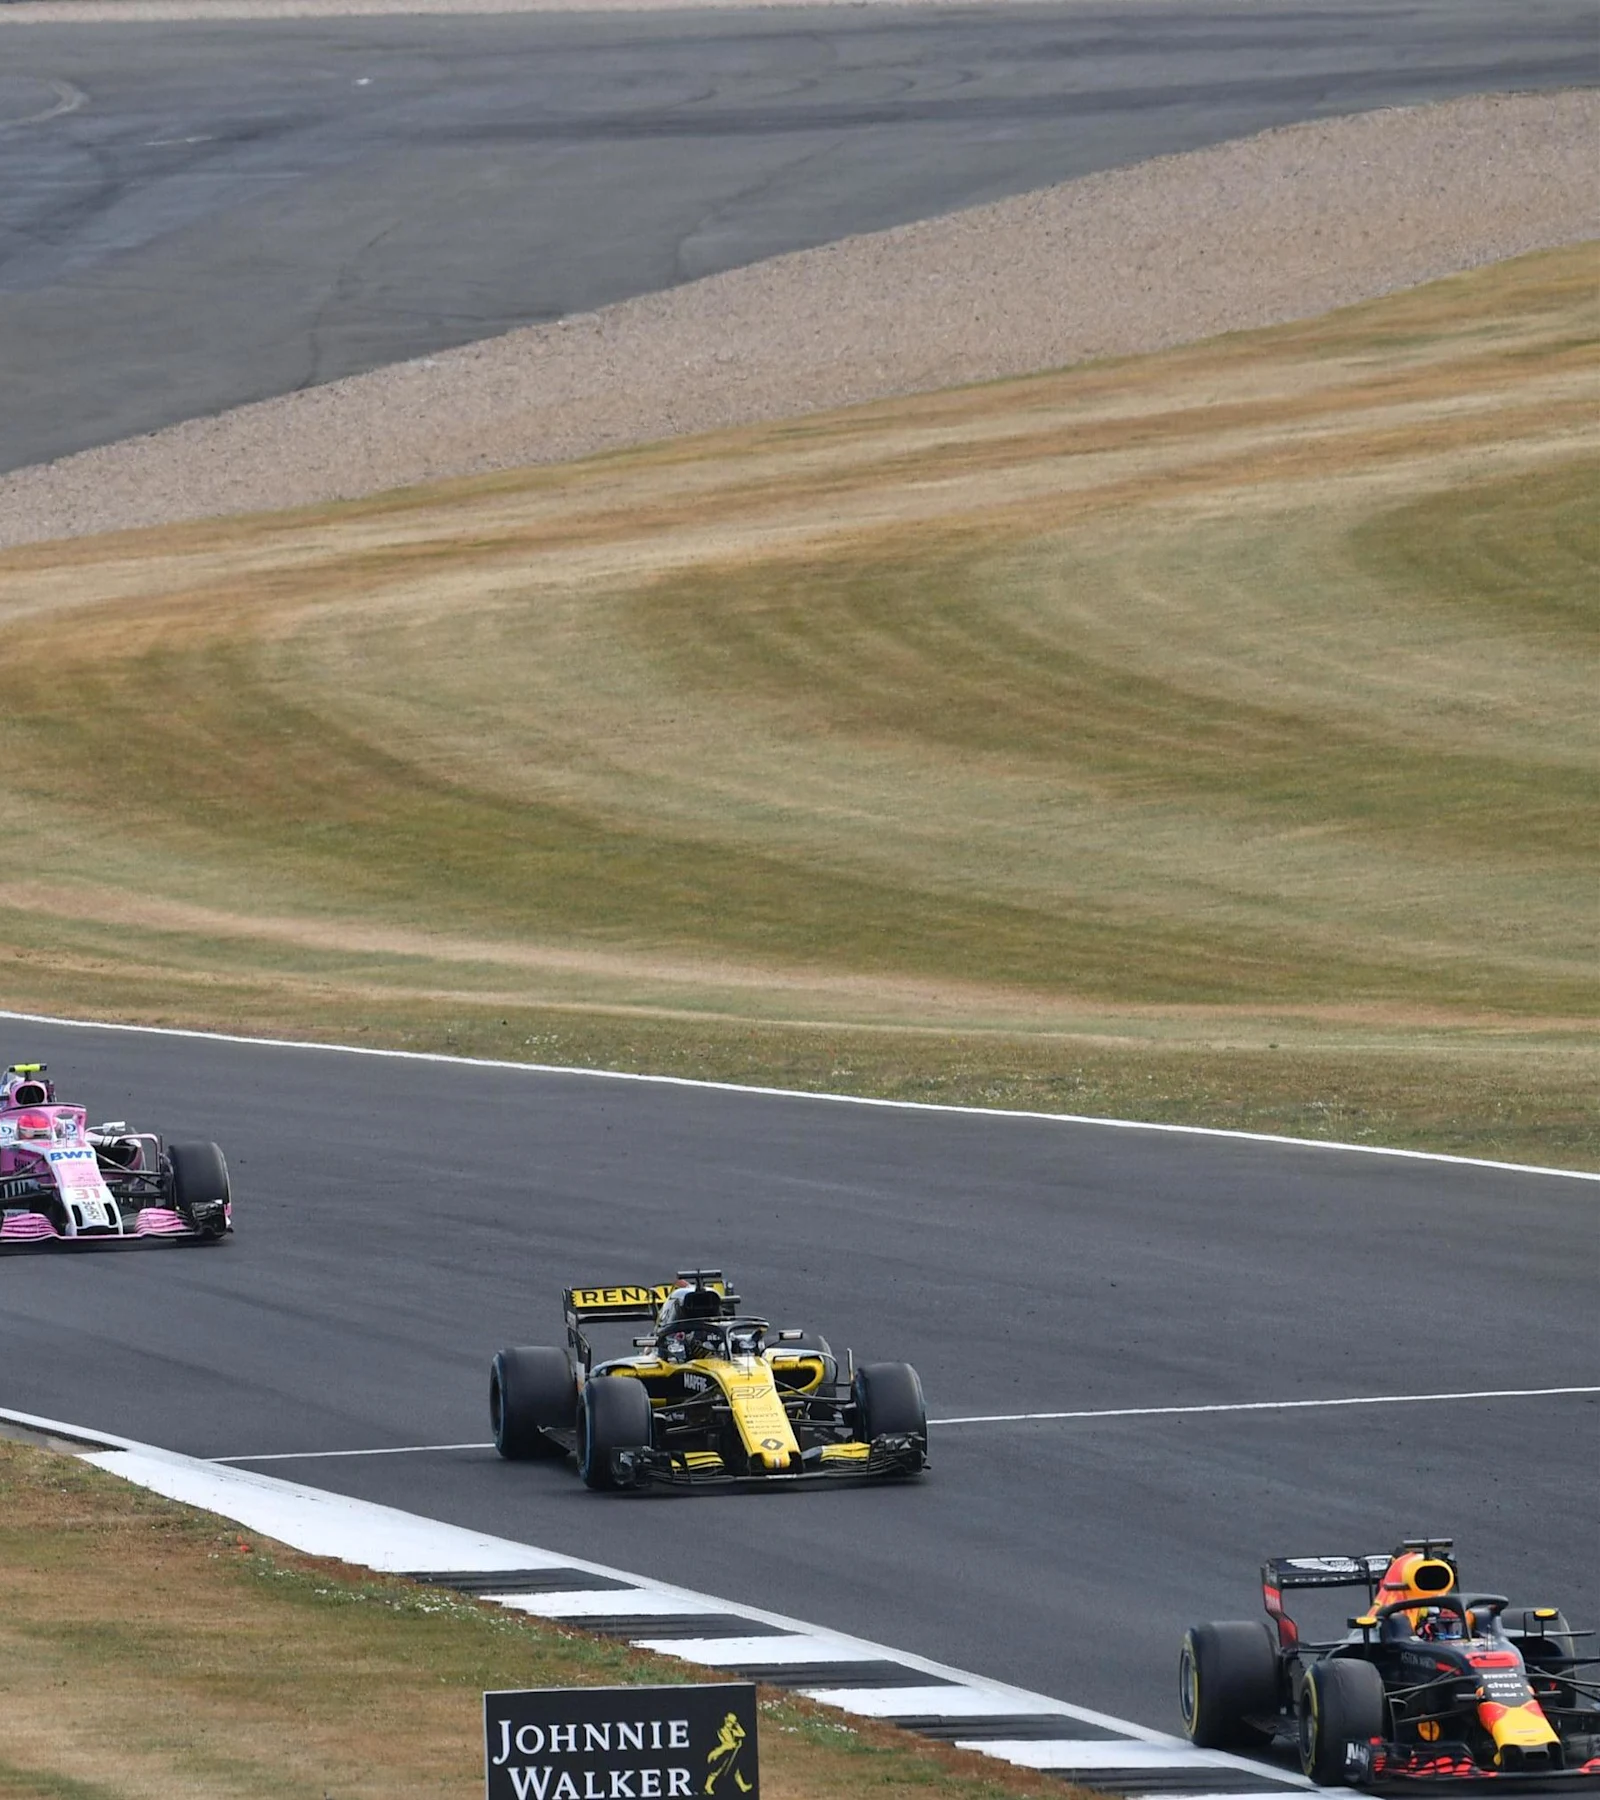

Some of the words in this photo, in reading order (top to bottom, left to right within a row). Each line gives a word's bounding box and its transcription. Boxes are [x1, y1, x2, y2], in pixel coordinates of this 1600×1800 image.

[50, 1150, 93, 1161] BWT
[74, 1188, 101, 1200] 31
[731, 1385, 773, 1401] 27
[492, 1719, 690, 1765] JOHNNIE
[507, 1765, 693, 1800] WALKER
